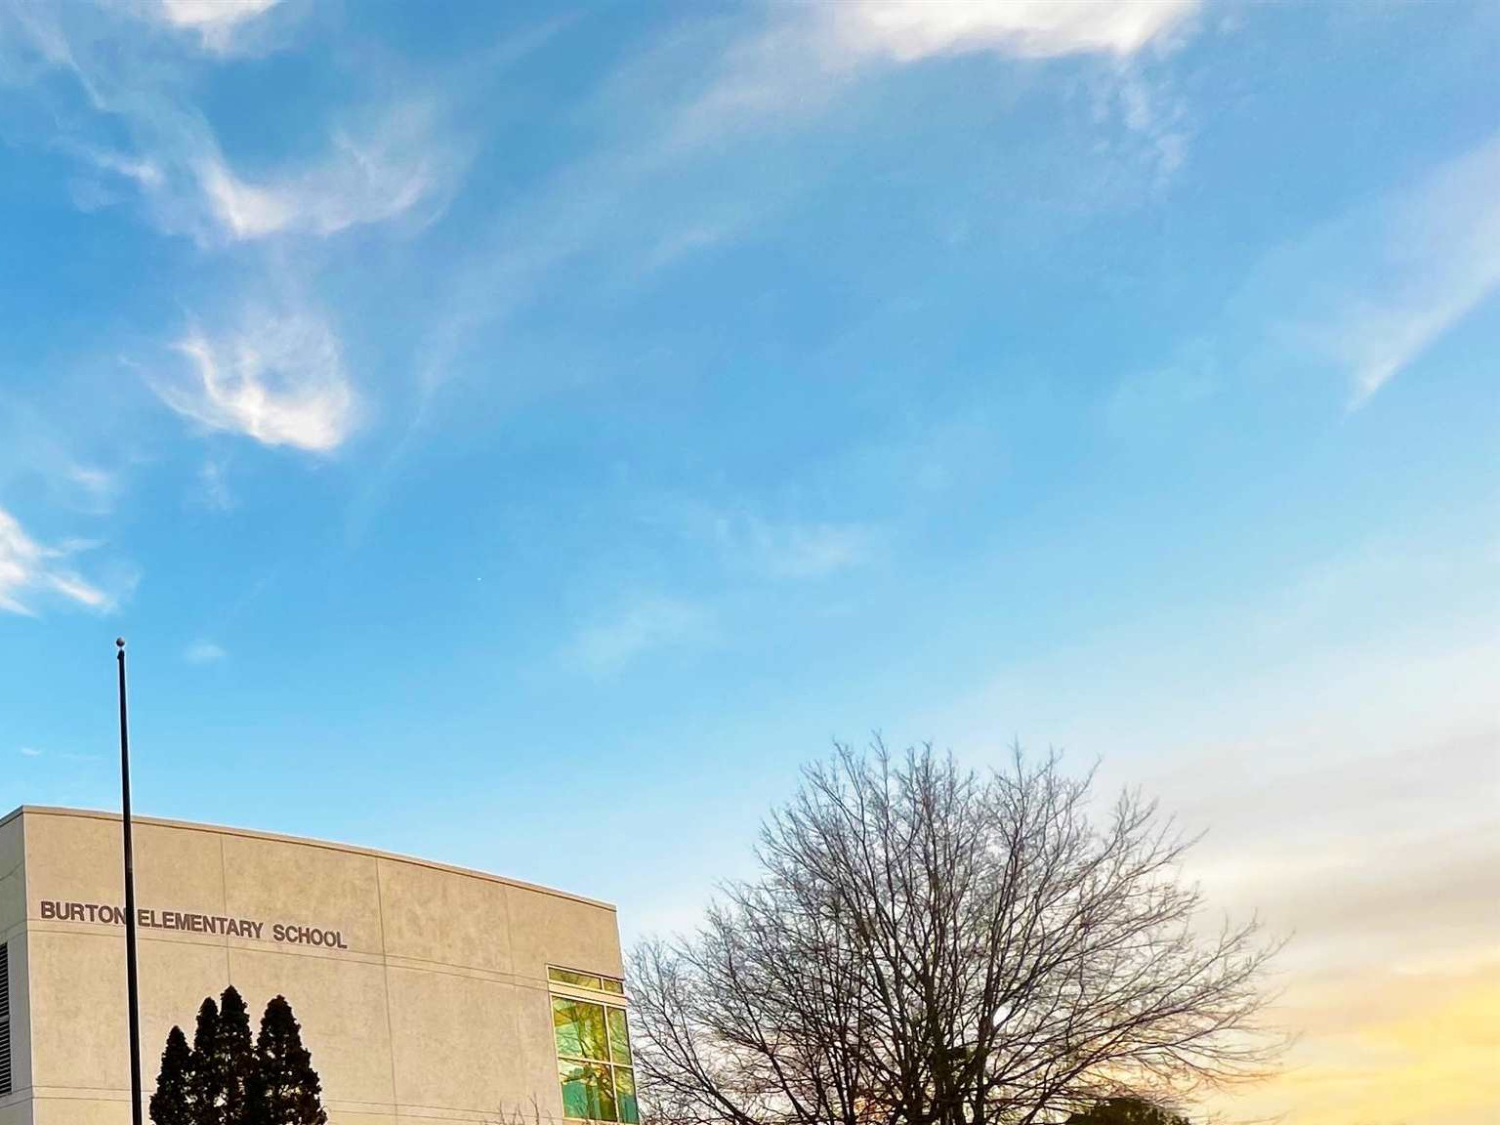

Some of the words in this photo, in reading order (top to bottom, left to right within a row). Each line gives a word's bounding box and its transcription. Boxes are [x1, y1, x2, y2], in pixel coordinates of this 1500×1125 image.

[40, 900, 126, 925] BURTON
[137, 908, 264, 939] ELEMENTARY
[272, 923, 348, 949] SCHOOL
